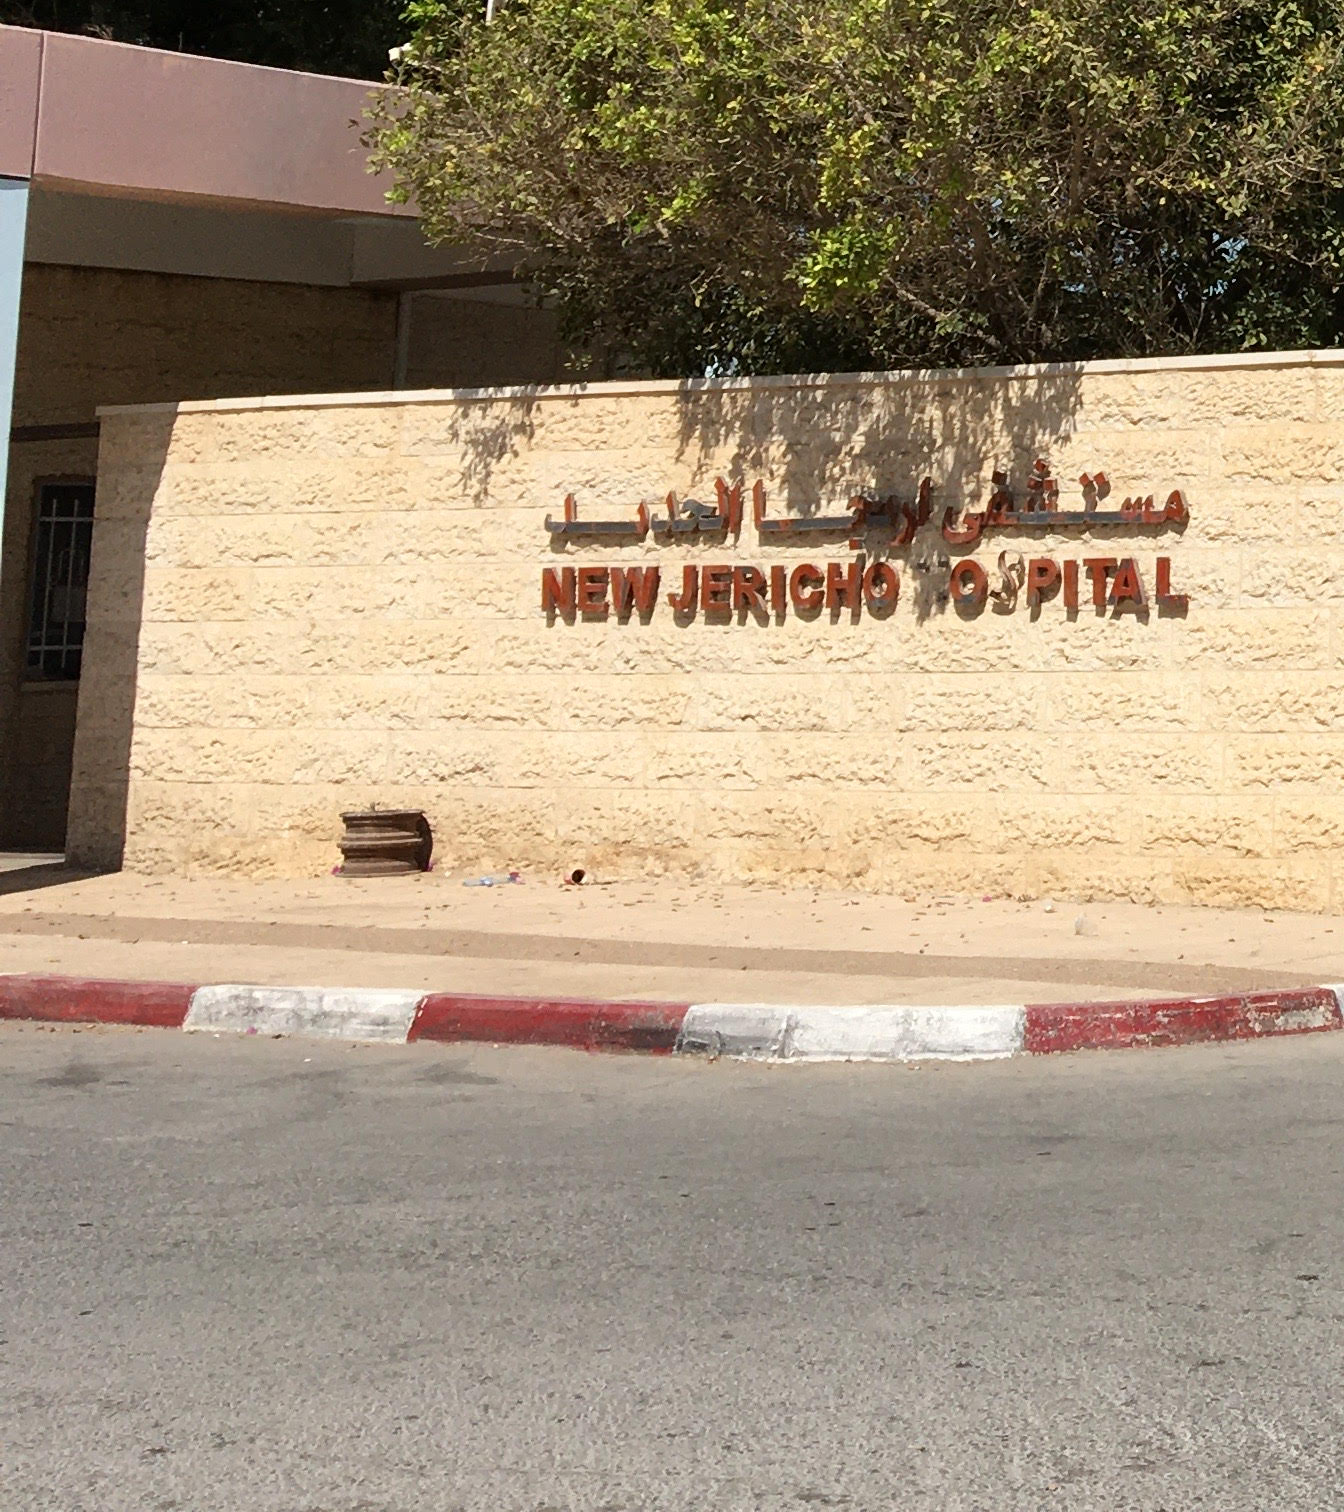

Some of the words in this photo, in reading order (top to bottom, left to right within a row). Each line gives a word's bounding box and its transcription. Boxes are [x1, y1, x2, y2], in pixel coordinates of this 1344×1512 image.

[541, 566, 660, 613] NEW
[667, 561, 900, 615] JERICHO
[915, 551, 1191, 612] OSPITAL
